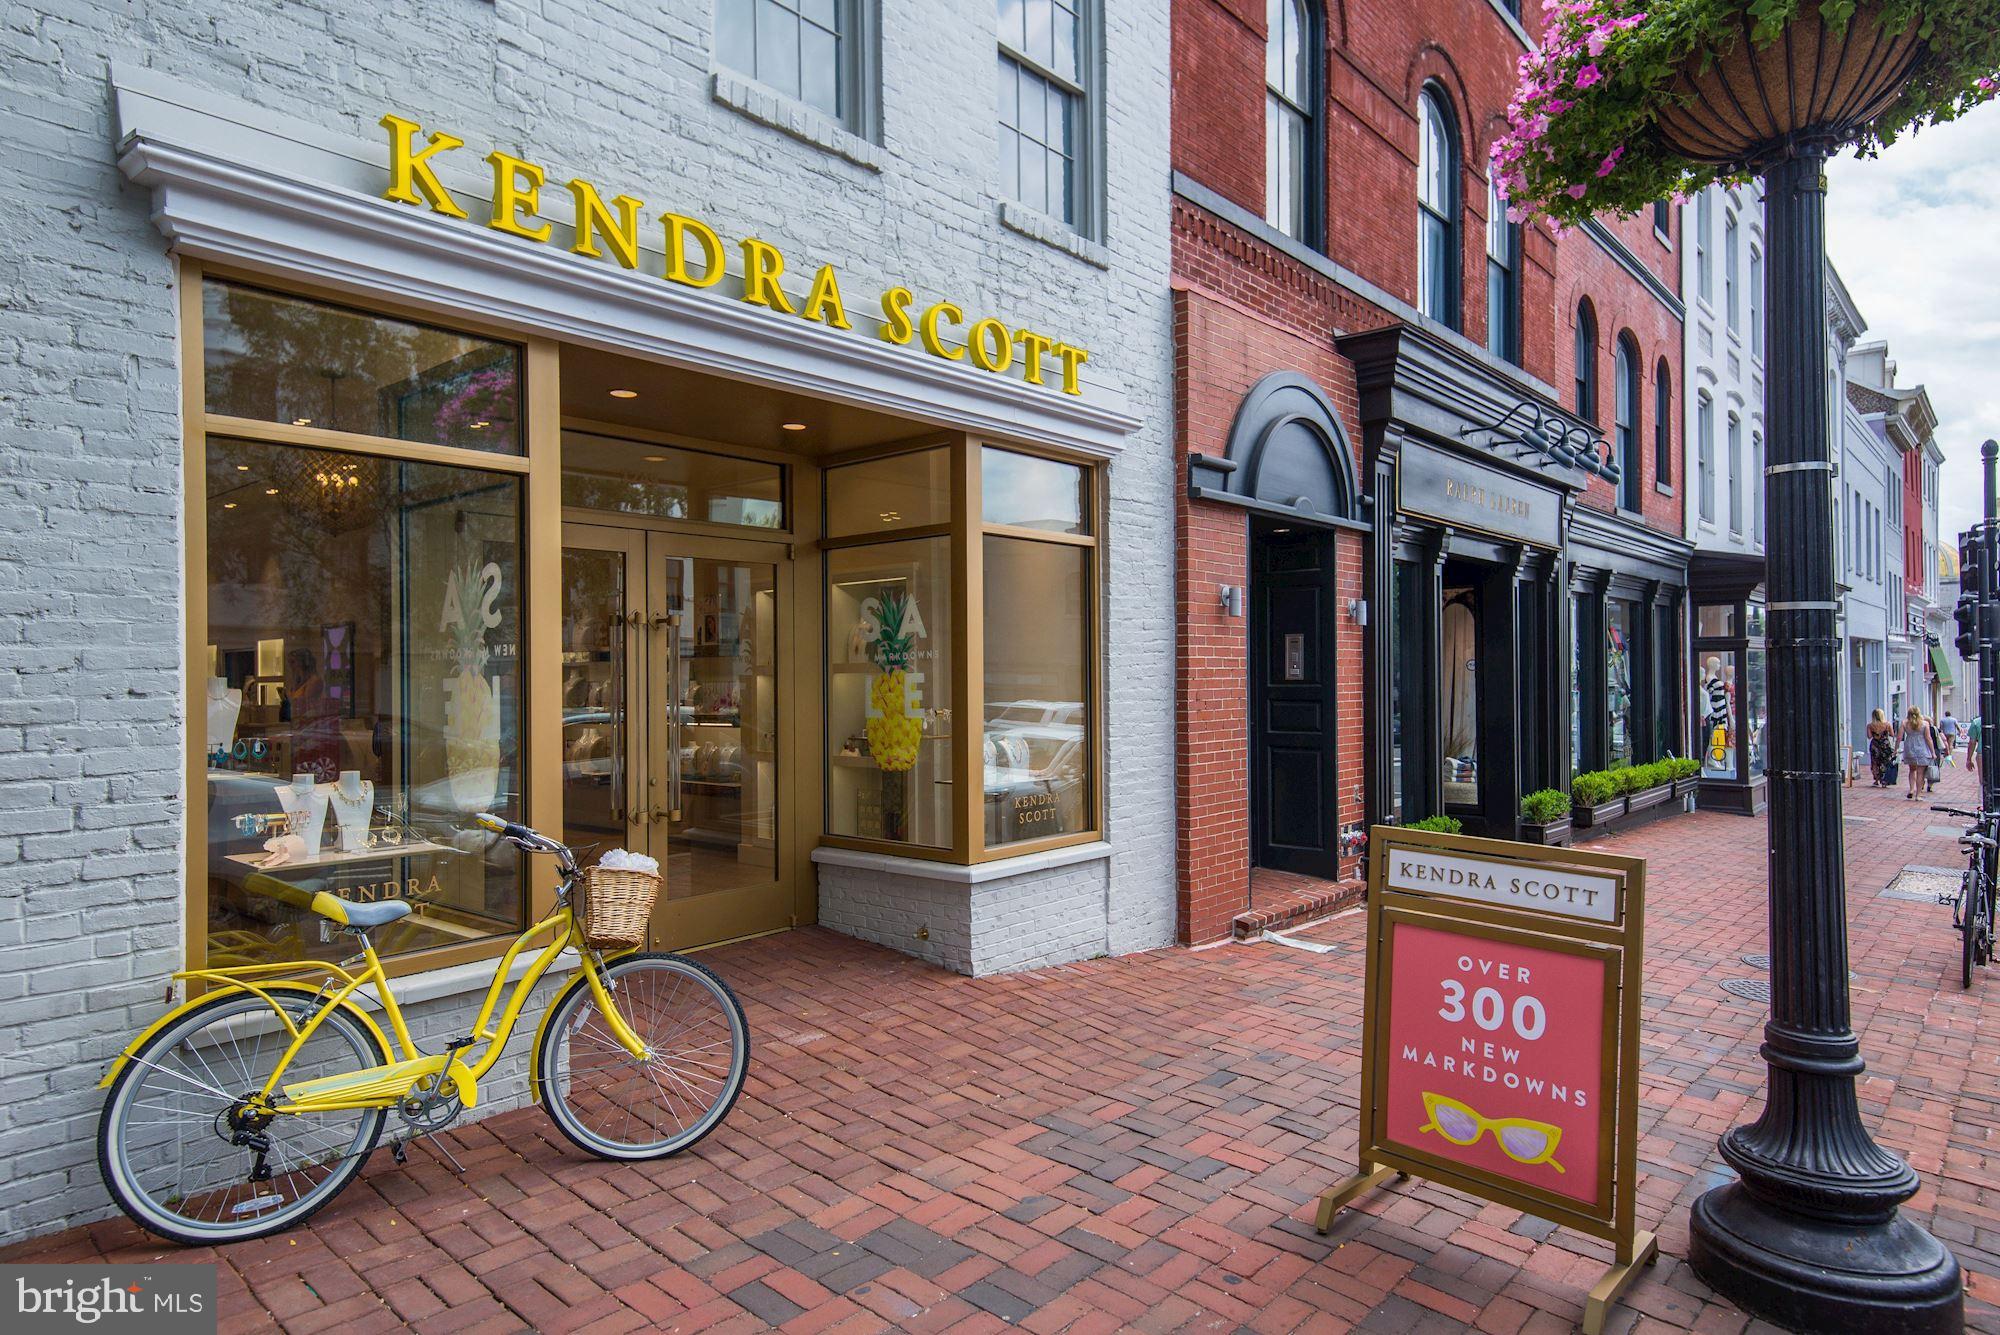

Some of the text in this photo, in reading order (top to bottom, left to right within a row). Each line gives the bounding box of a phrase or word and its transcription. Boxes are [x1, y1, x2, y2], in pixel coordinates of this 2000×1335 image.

[379, 113, 1088, 396] KENDRA SCOTT
[1014, 792, 1060, 809] KENDRA
[1018, 808, 1057, 824] SCOTT
[315, 875, 442, 903] ENDRA
[1399, 862, 1599, 907] KENDRA SCOTT
[1457, 955, 1532, 984] OVER
[1438, 979, 1547, 1041] 300
[1461, 1036, 1520, 1065] NEW
[1402, 1045, 1587, 1107] MARKDOWNS
